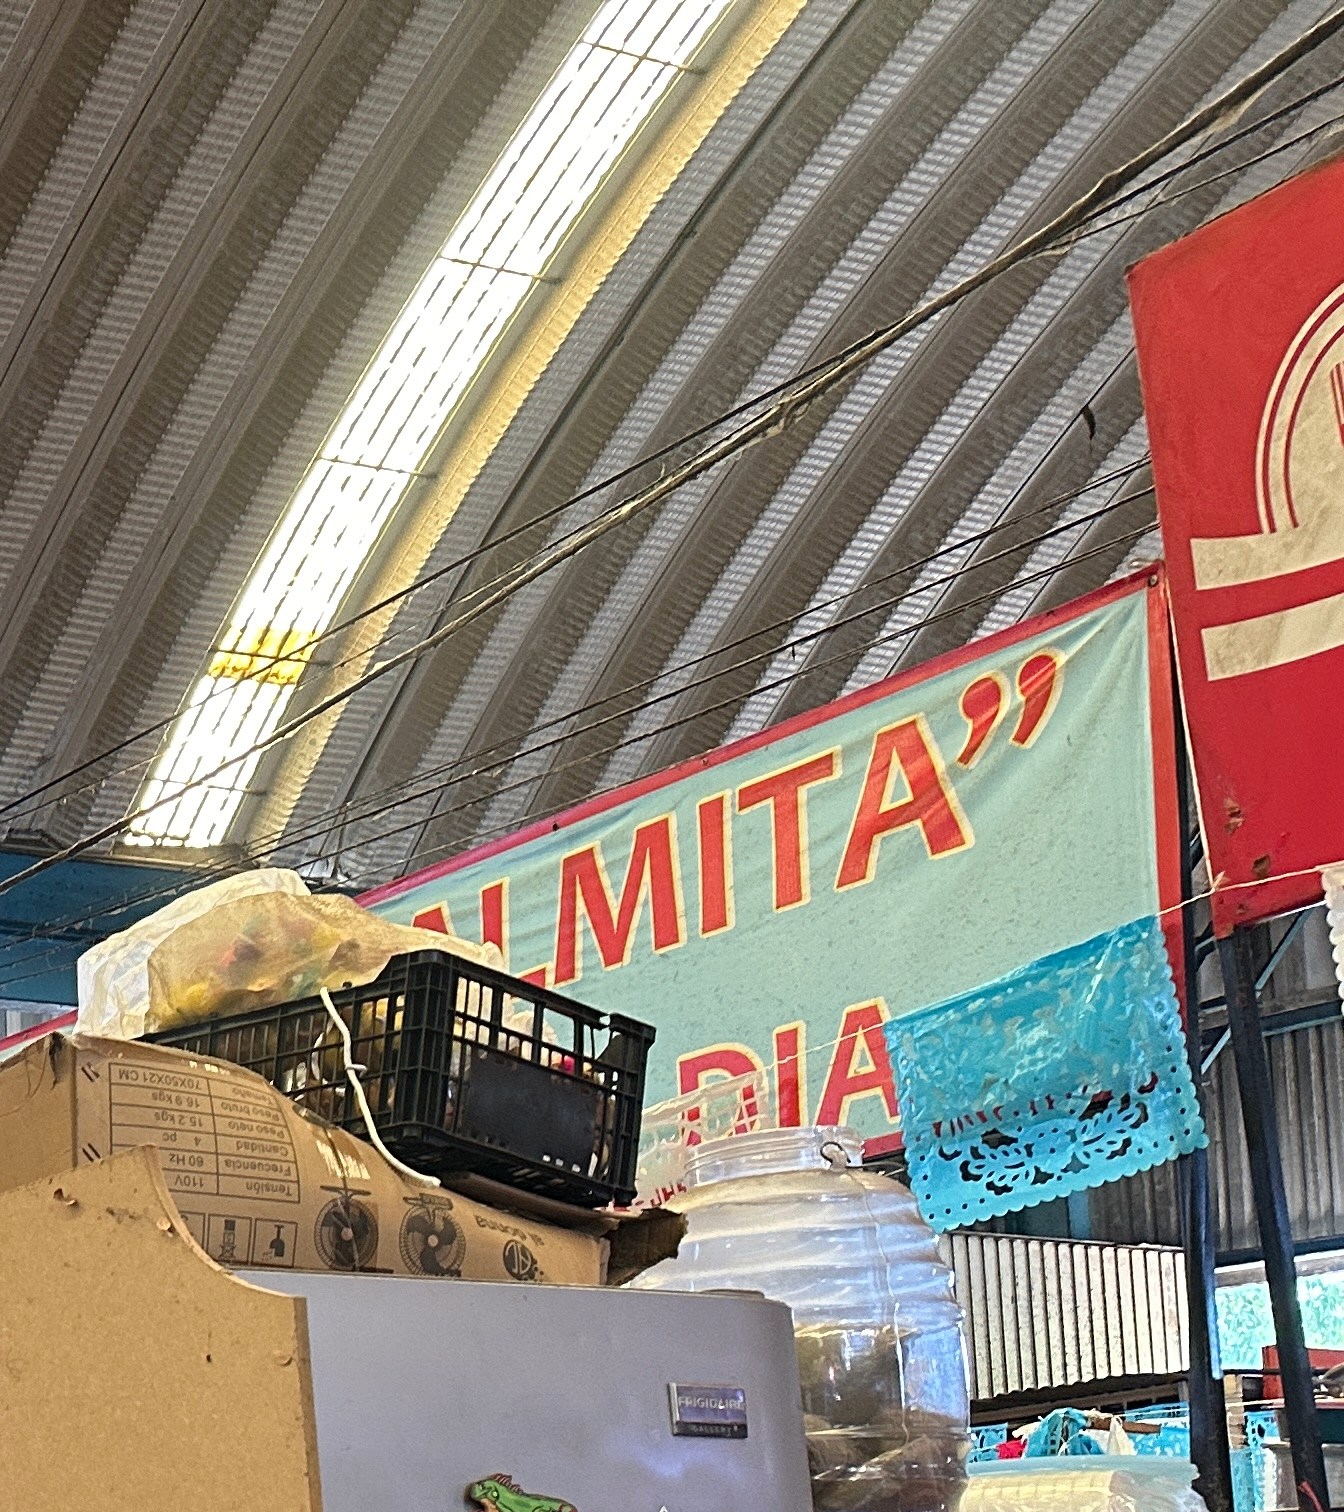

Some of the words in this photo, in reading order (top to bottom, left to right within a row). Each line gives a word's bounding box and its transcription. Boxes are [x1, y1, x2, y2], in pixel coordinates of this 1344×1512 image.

[118, 1068, 140, 1082] CM
[151, 1090, 173, 1106] kgs
[154, 1110, 176, 1126] kgs
[163, 1132, 177, 1143] pc
[255, 1124, 285, 1139] Peso
[194, 1136, 201, 1146] 4
[236, 1140, 288, 1158] Cantidad
[169, 1153, 185, 1166] Hz
[188, 1155, 203, 1167] 60
[224, 1158, 292, 1176] Frecuencia
[173, 1174, 204, 1188] 110V
[246, 1181, 292, 1196] Tensión
[677, 1396, 744, 1411] FRIGIDAIRE
